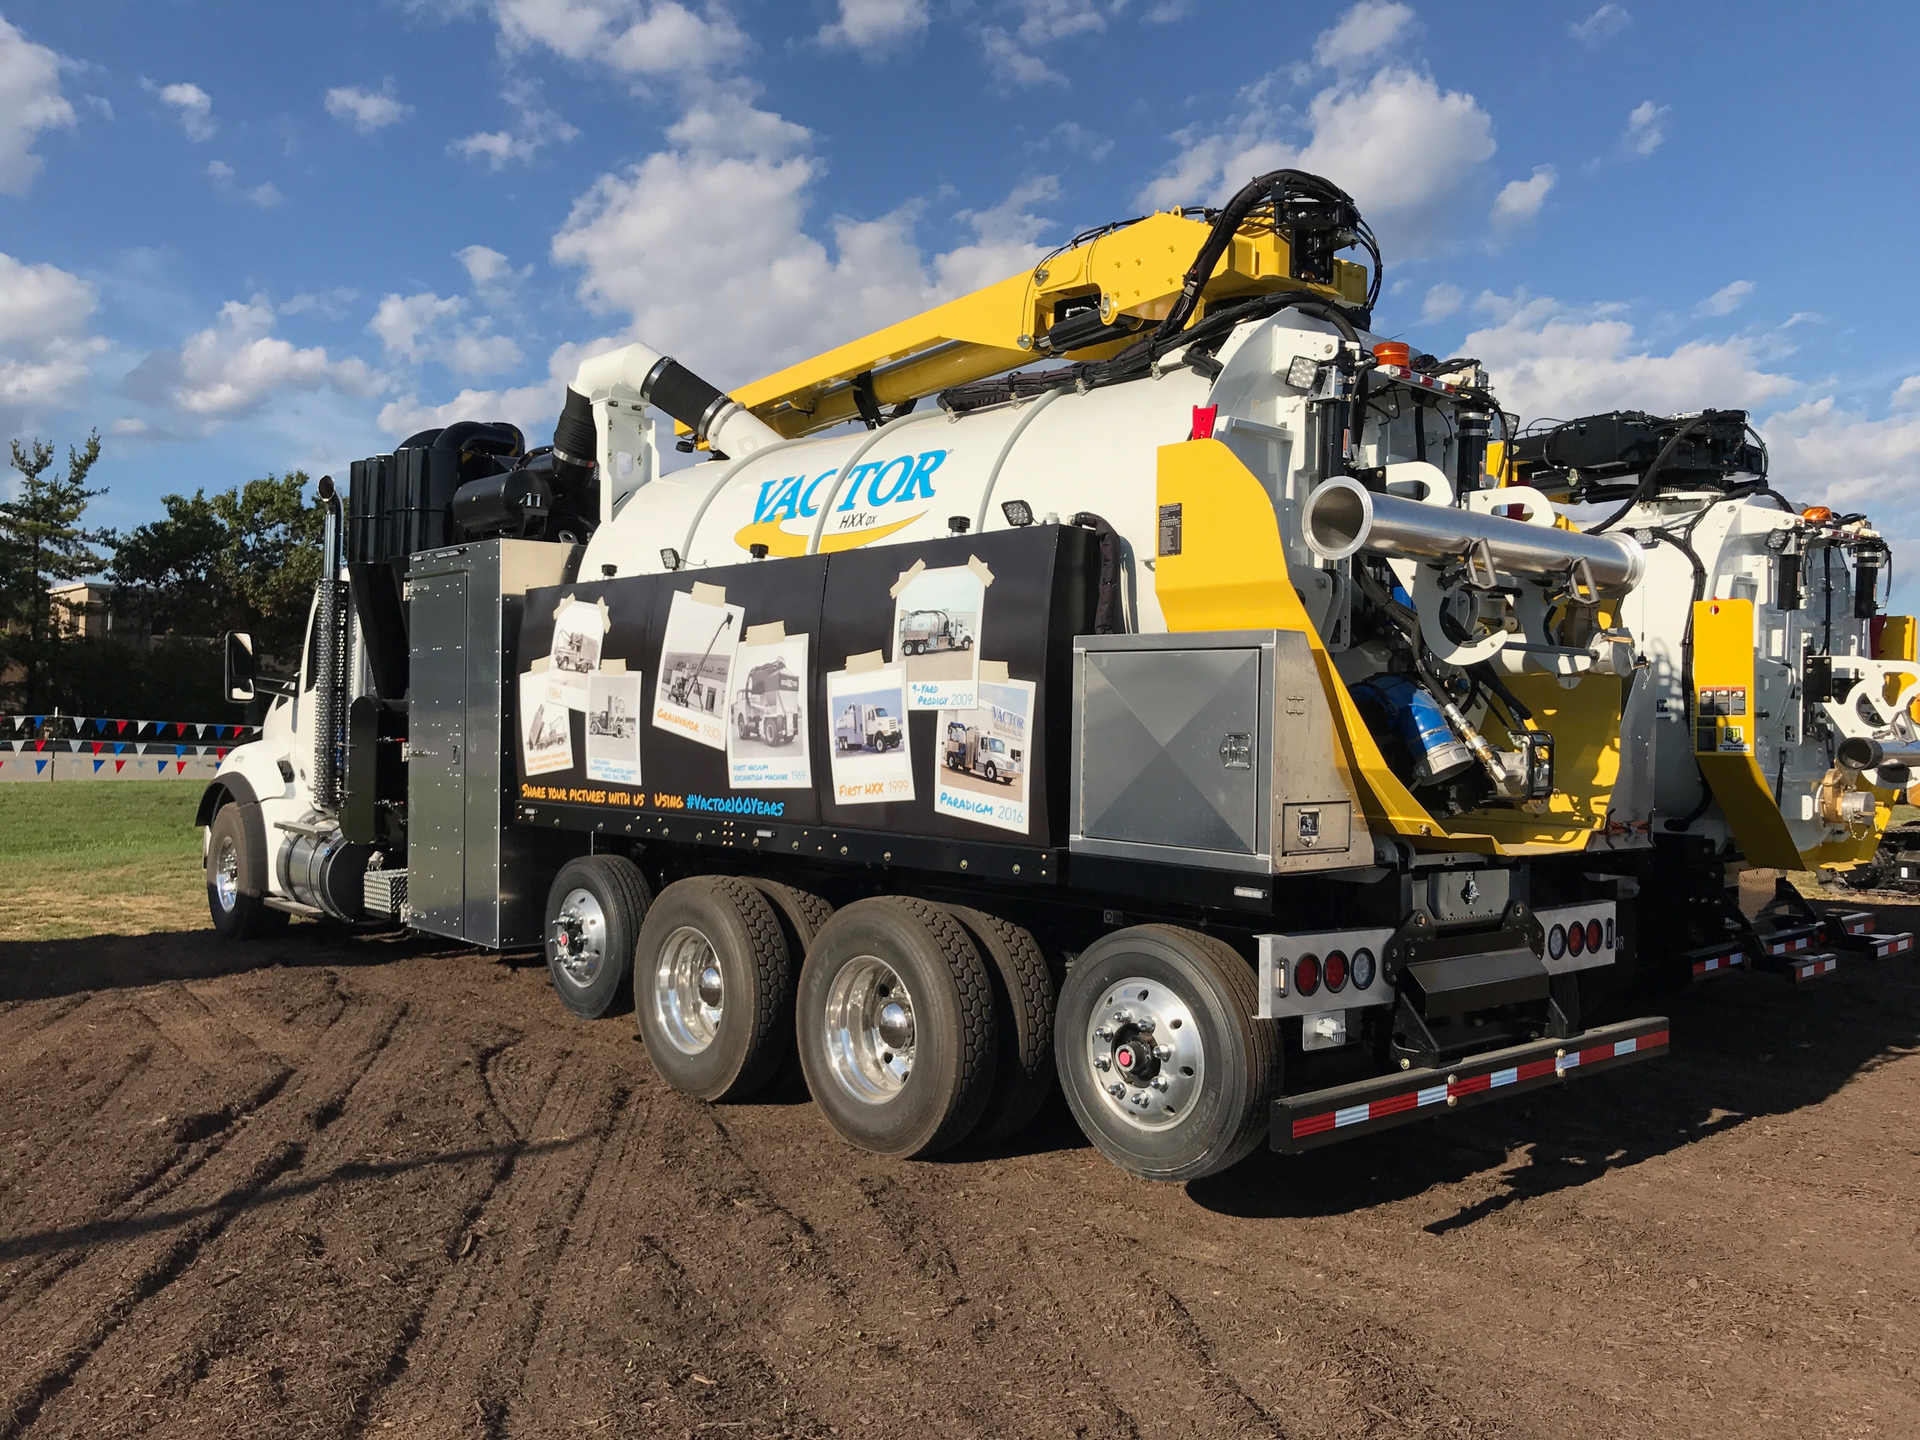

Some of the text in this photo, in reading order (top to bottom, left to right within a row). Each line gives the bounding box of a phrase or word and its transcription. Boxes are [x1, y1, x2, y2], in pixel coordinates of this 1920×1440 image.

[753, 449, 947, 525] VACTOR
[839, 512, 868, 529] HXX
[918, 694, 974, 706] PRODIGY 2009
[992, 706, 1024, 729] VACTOR
[764, 773, 788, 781] MACHINE
[791, 770, 806, 781] 1969
[521, 783, 546, 799] SHARE
[548, 786, 568, 801] YOUR
[569, 788, 606, 804] PICTURES
[608, 791, 630, 805] WITH
[633, 793, 646, 807] US
[654, 792, 685, 810] USING
[839, 780, 908, 797] FIRST HXX 1999
[940, 792, 1024, 824] PARADIGM 2016
